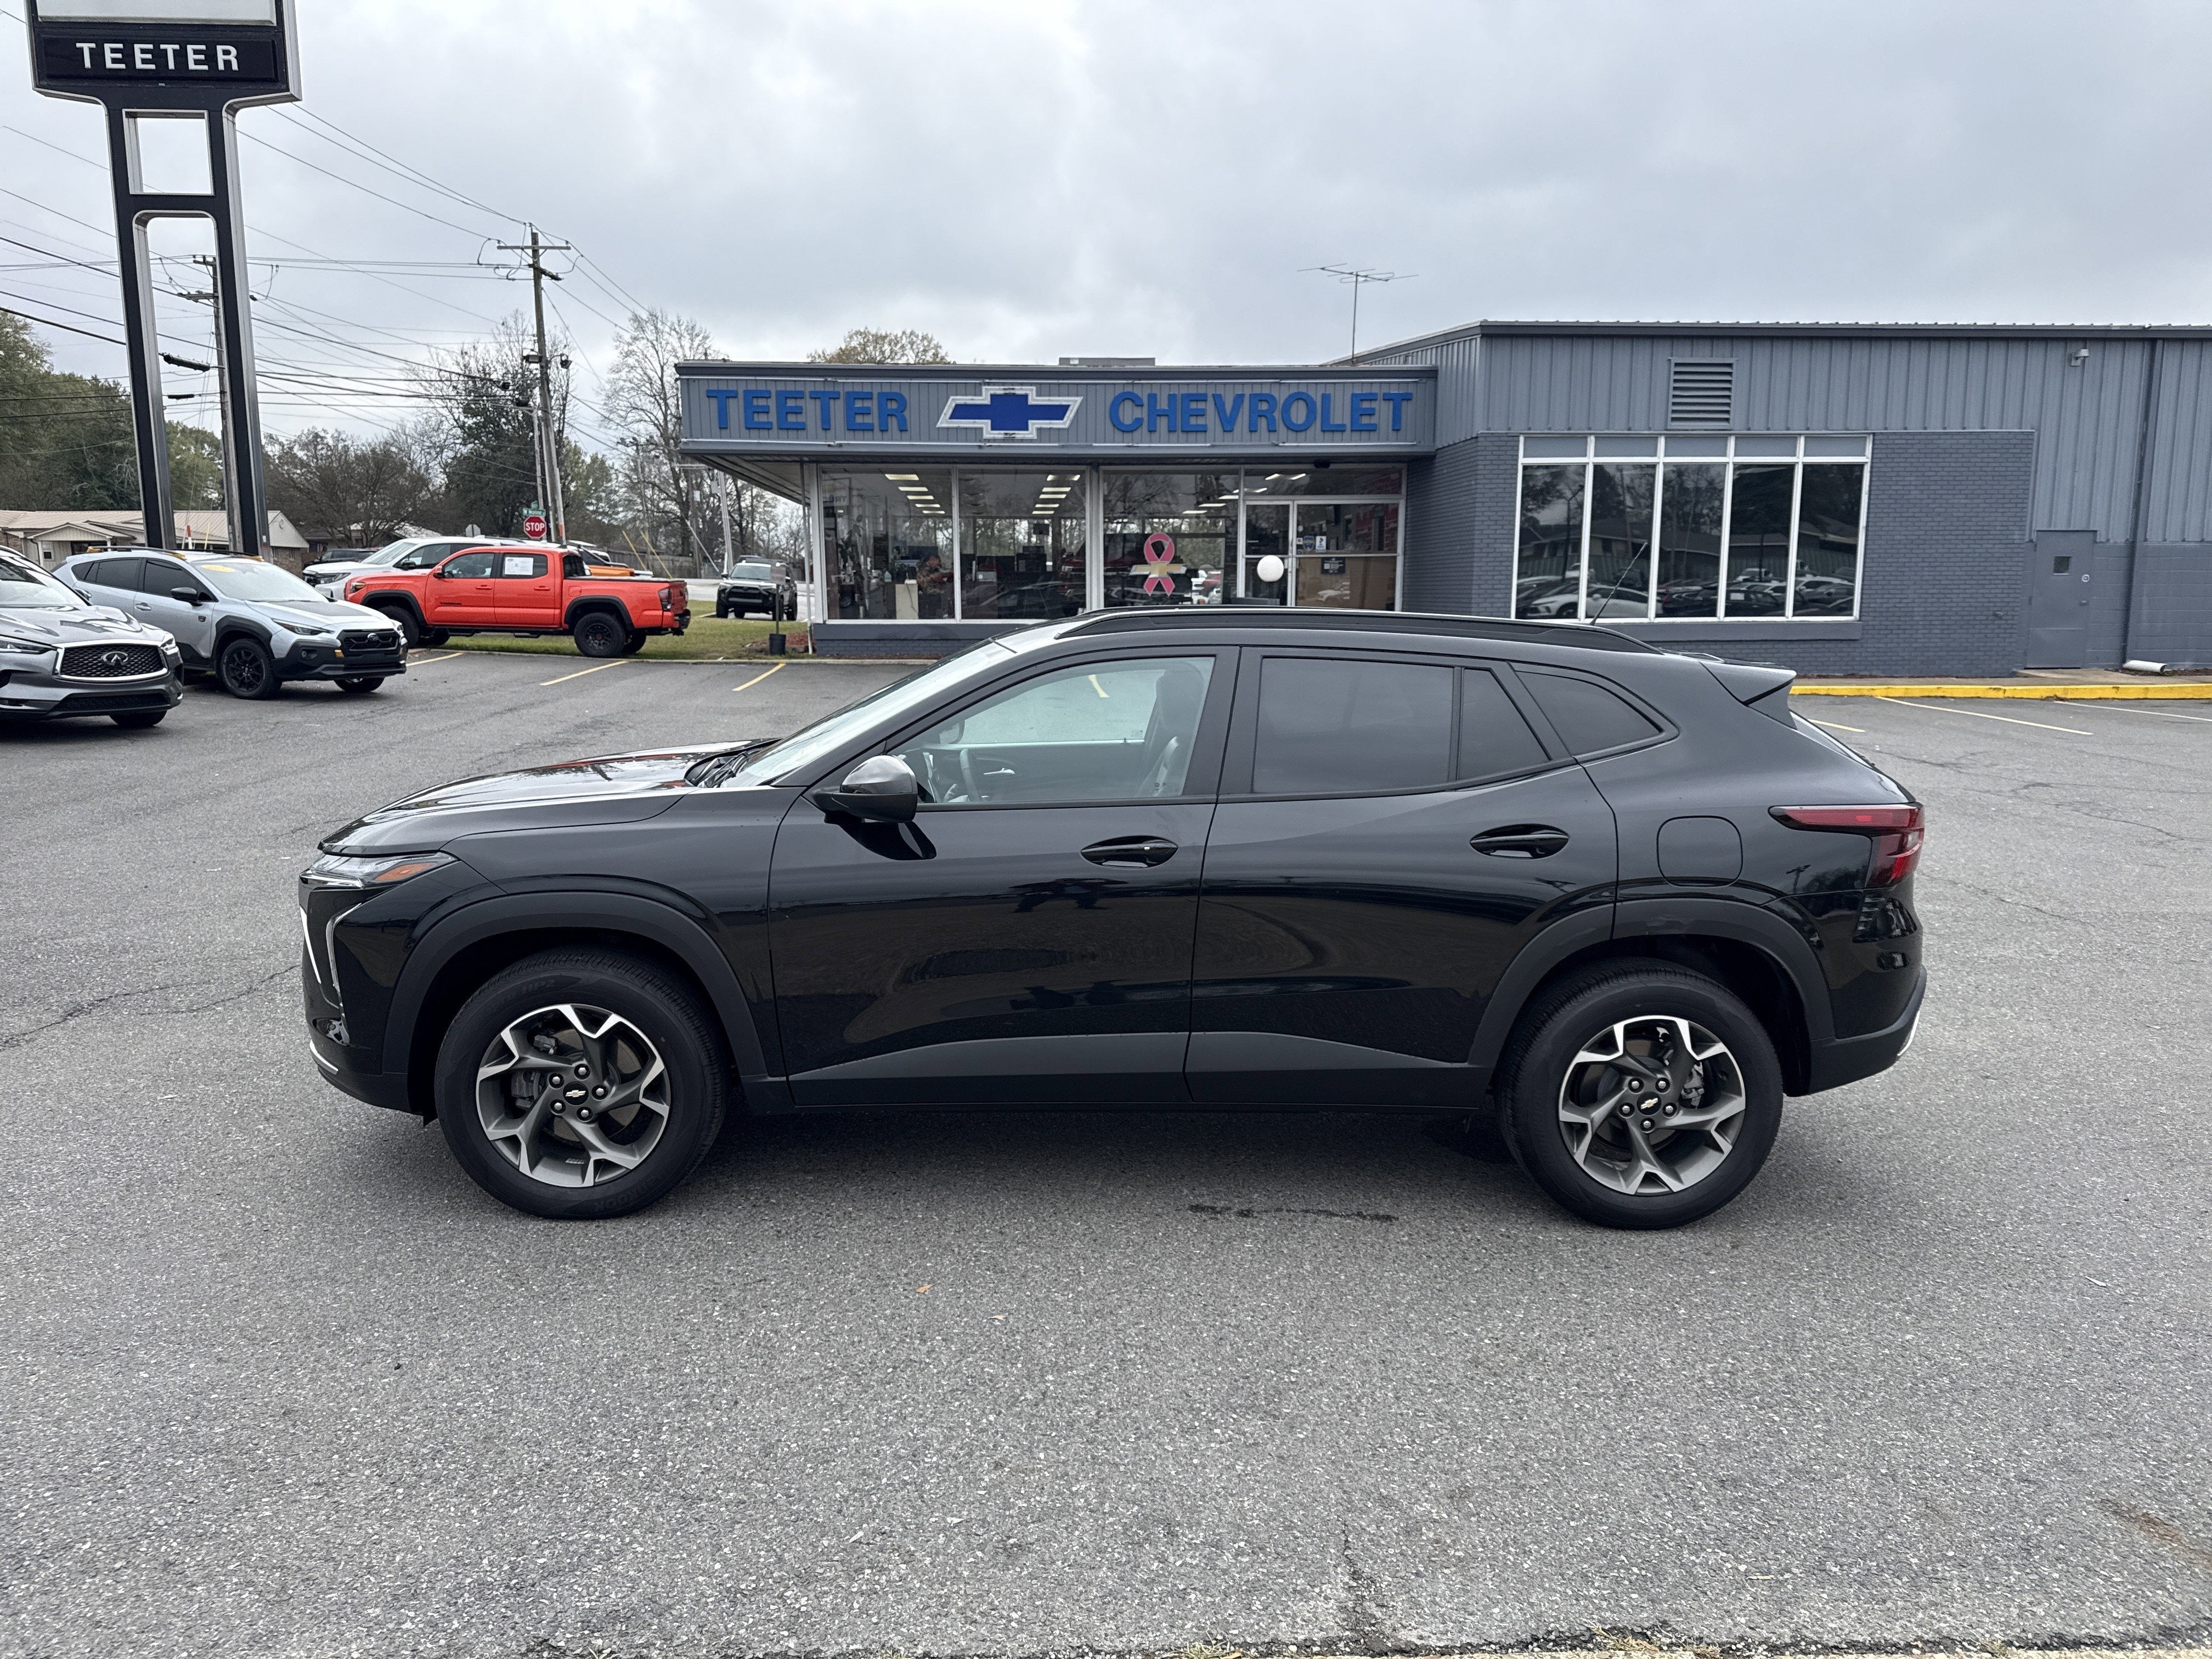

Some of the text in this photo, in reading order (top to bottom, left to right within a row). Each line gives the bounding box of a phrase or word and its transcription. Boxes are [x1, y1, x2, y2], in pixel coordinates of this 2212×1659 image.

[76, 43, 239, 71] TEETER
[706, 390, 1413, 432] TEETER CHEVROLET
[526, 522, 545, 532] STOP
